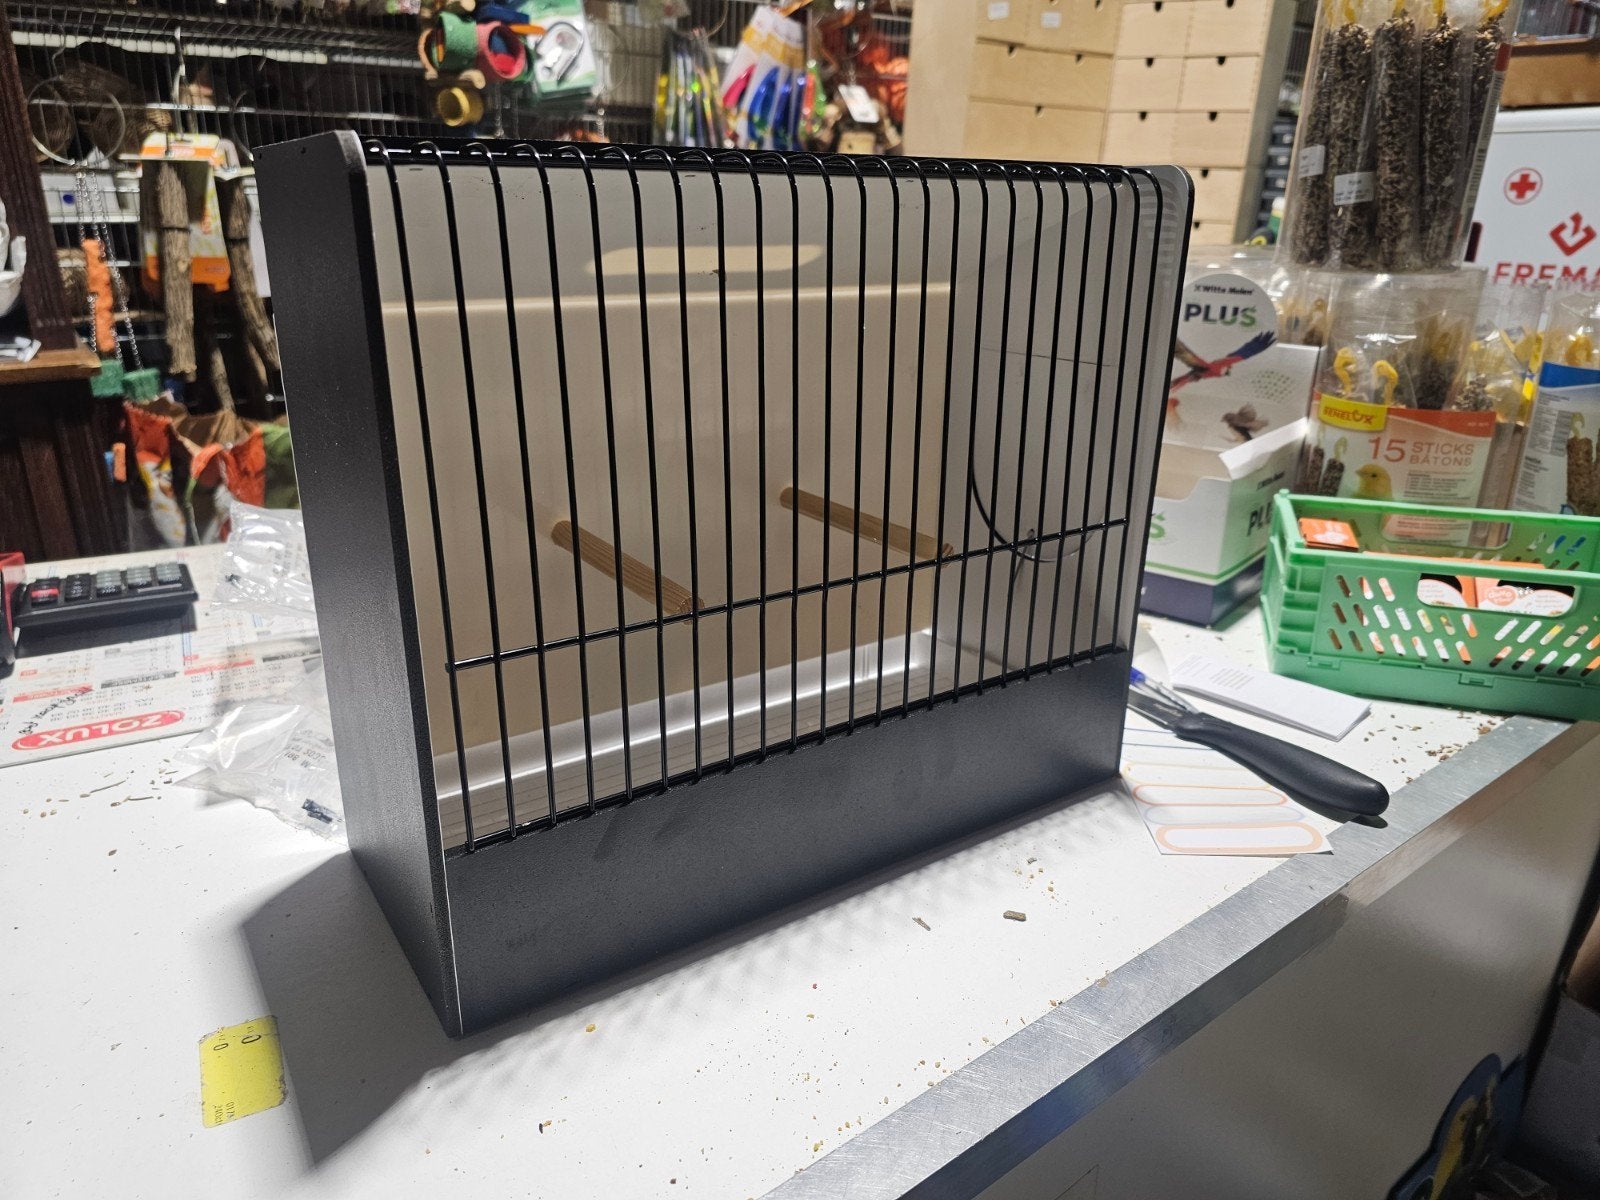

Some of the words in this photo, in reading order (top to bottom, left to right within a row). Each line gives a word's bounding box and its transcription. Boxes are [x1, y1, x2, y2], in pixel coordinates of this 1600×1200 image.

[1184, 303, 1257, 328] PLUS
[1368, 436, 1406, 463] 15
[1412, 441, 1475, 456] STICKS
[37, 714, 163, 748] ZOLUX
